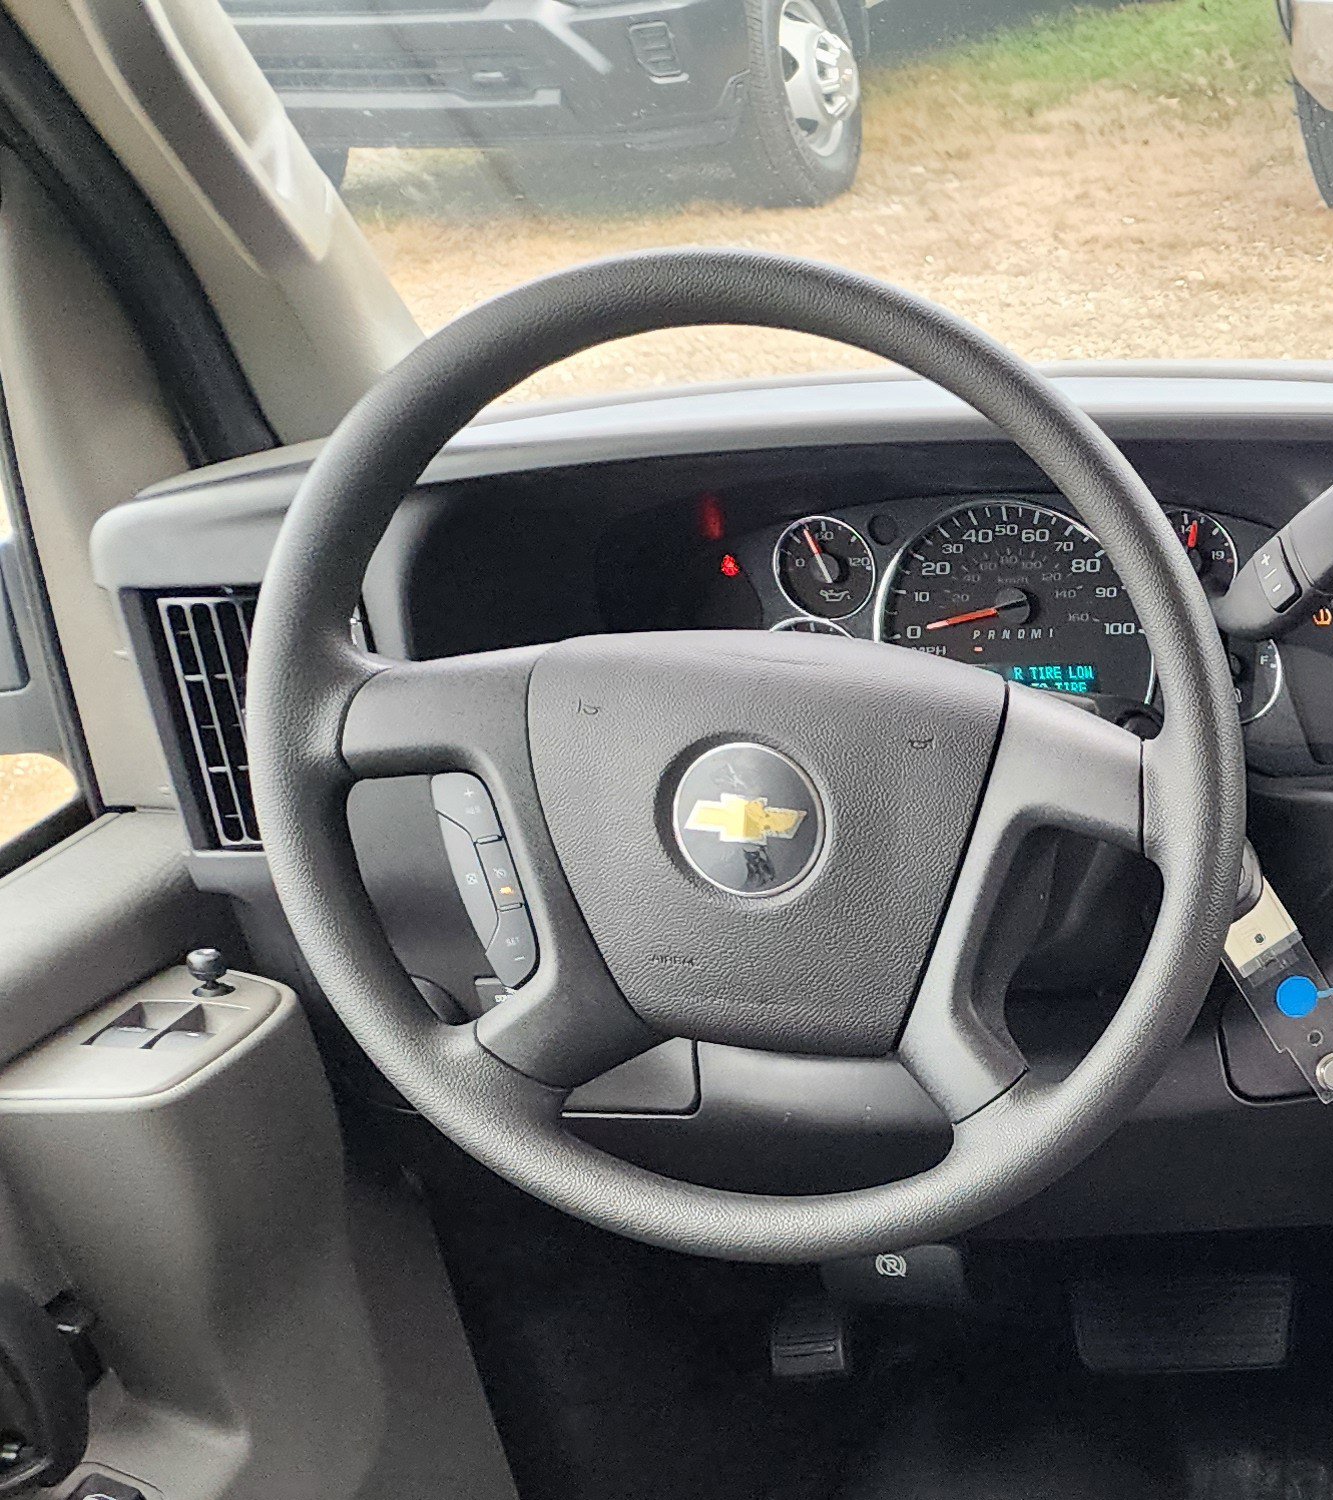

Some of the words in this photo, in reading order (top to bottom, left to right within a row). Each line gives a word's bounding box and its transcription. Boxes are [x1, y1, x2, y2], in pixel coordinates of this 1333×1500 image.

[995, 524, 1018, 535] 50
[963, 529, 993, 543] 40
[1021, 529, 1050, 542] 60
[942, 543, 963, 554] 30
[1054, 541, 1074, 552] 70
[1211, 550, 1225, 560] 19
[795, 559, 806, 567] 0
[850, 557, 871, 567] 120
[1071, 558, 1101, 573] 80
[921, 562, 951, 575] 20
[914, 591, 930, 602] 10
[1055, 589, 1077, 598] 140
[1095, 587, 1117, 598] 90
[906, 625, 922, 639] 0
[1103, 622, 1136, 635] 100
[911, 645, 947, 656] PH
[1260, 655, 1269, 665] F
[1028, 665, 1062, 680] TIRE
[1068, 665, 1095, 680] LOW
